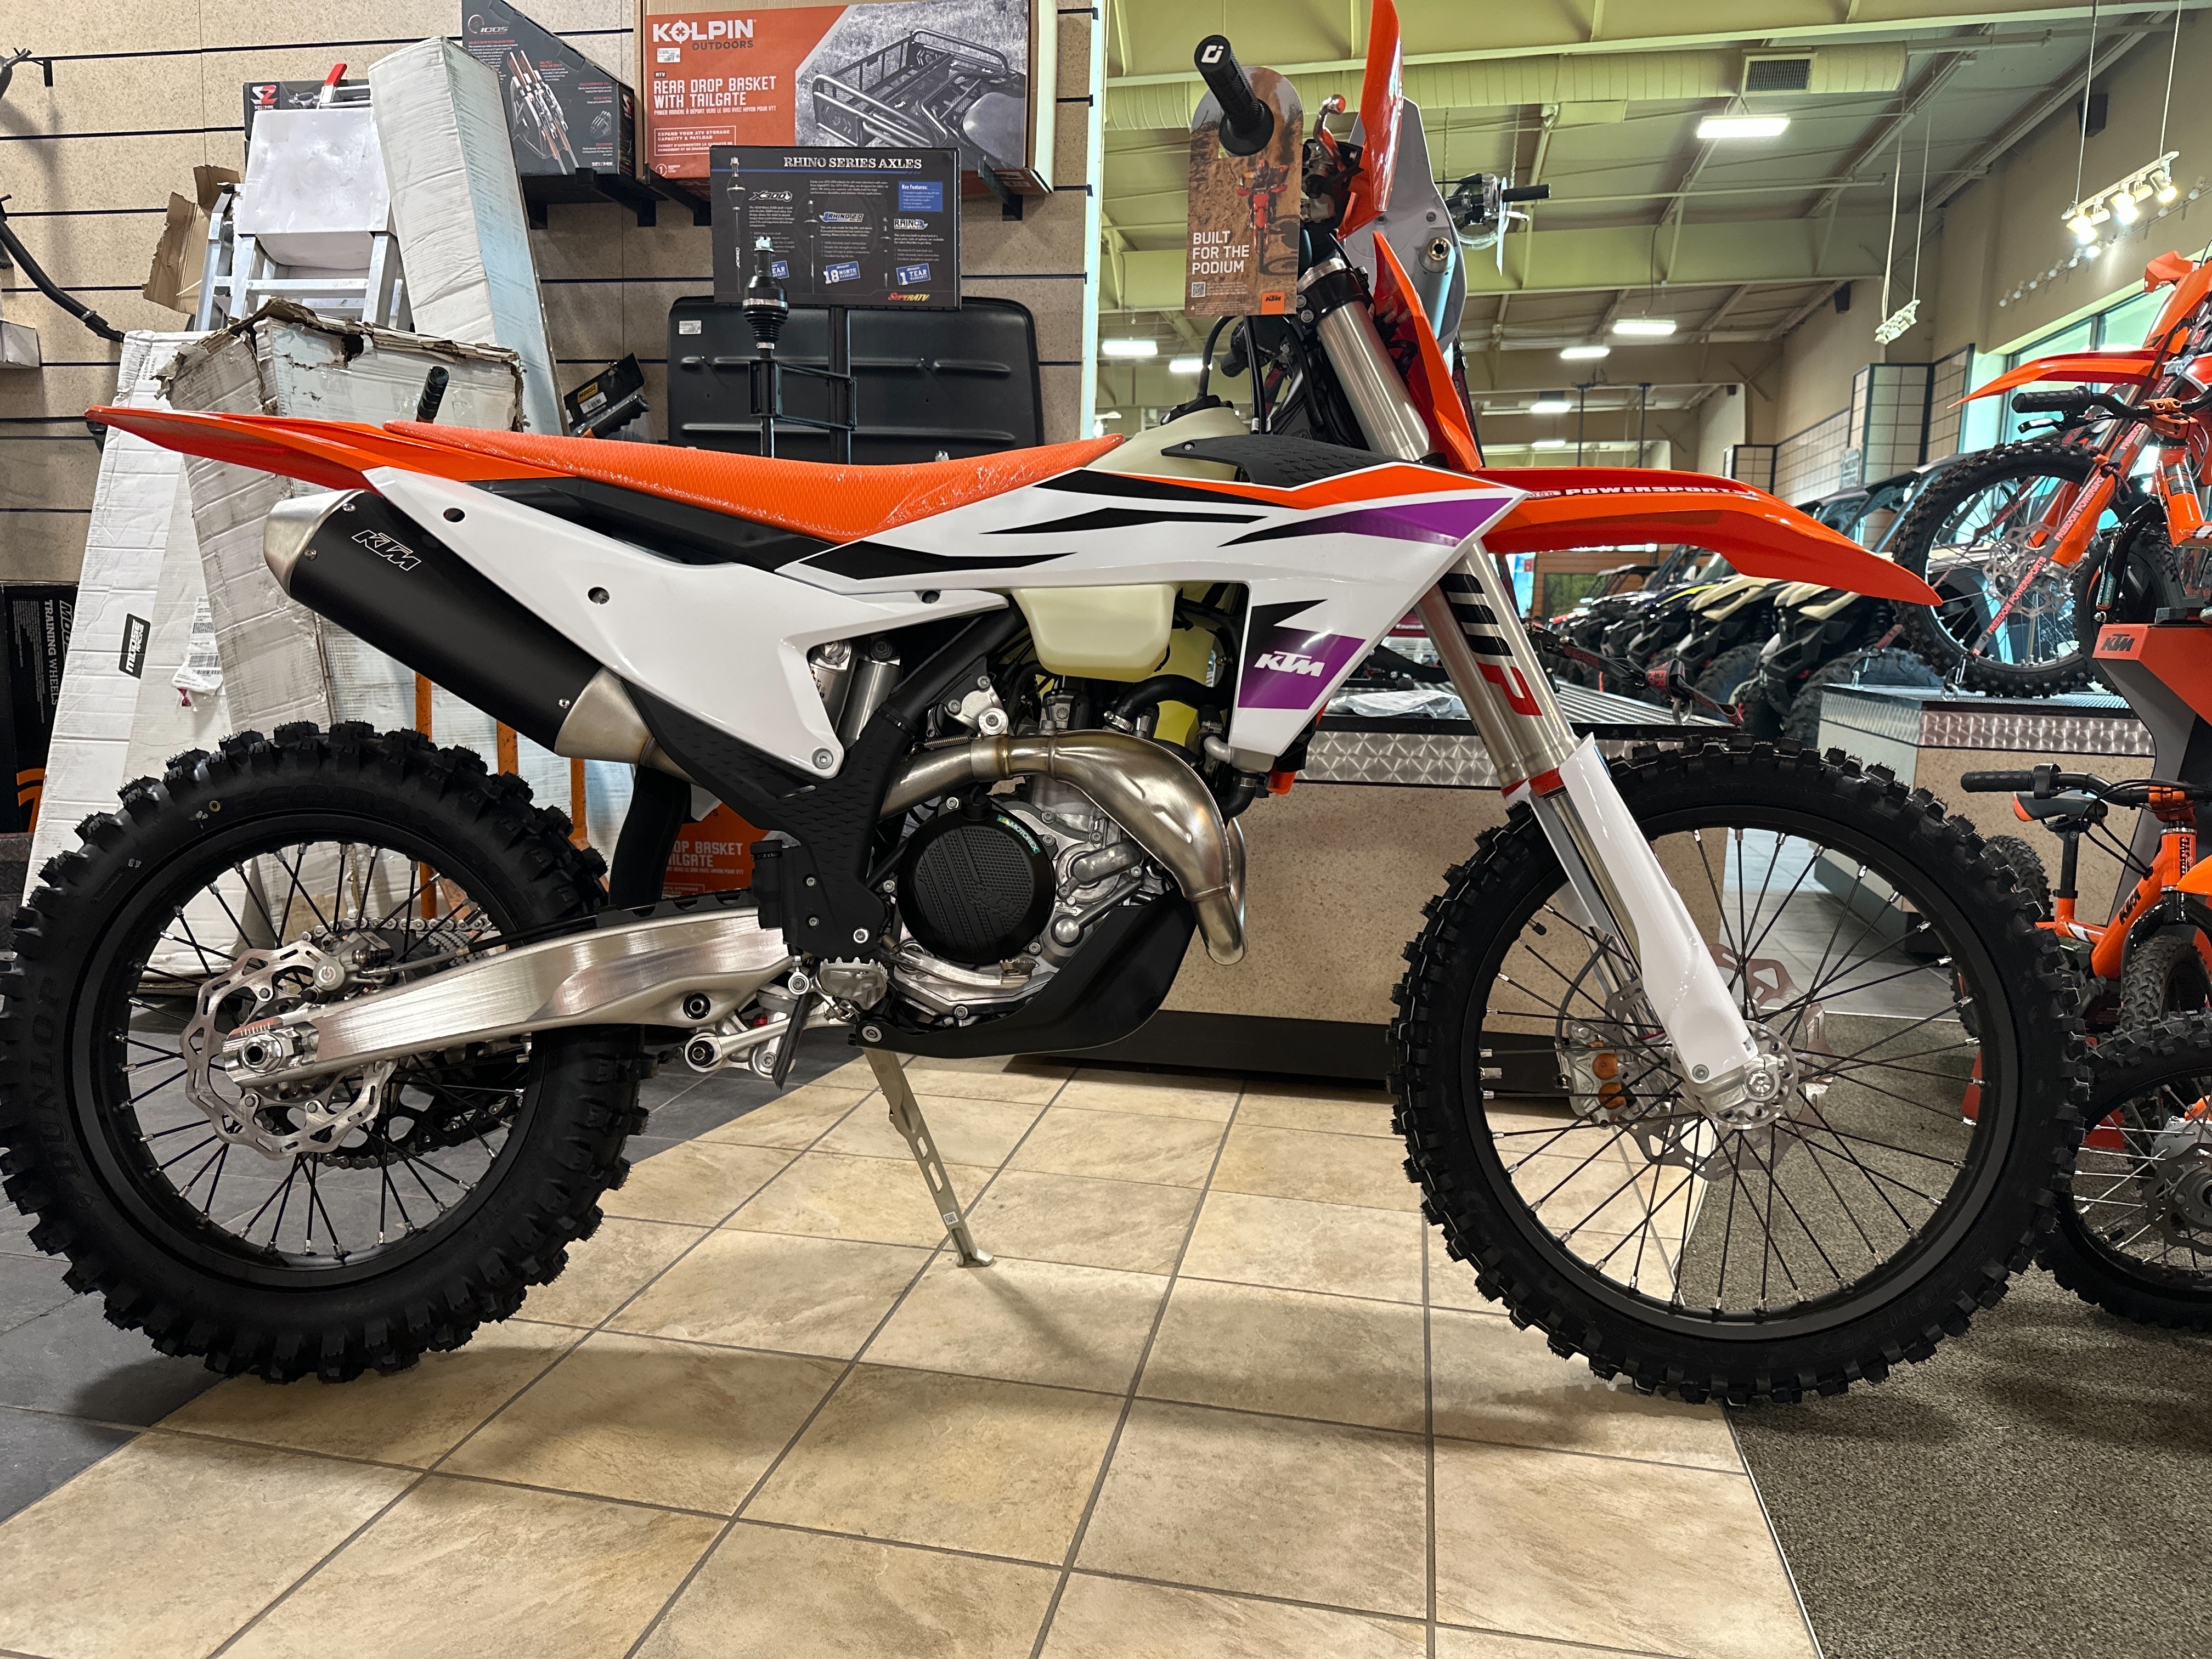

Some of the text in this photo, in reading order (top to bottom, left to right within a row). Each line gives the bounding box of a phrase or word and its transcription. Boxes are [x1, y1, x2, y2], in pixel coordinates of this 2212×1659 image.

[653, 19, 754, 44] KOLPIN
[692, 41, 754, 50] OUTDOORS
[654, 76, 776, 94] REAR DROP BASKET
[654, 92, 747, 109] WITH TAILGATE
[783, 157, 922, 170] RHINO SERIES AXLES
[749, 190, 787, 201] X300
[1193, 230, 1231, 245] BUILT
[1193, 245, 1250, 260] FOR THE
[1192, 260, 1244, 274] PODIUM
[823, 269, 839, 284] 18
[900, 272, 909, 285] 1
[351, 529, 421, 571] KTM
[2101, 634, 2135, 652] KTM
[44, 600, 59, 706] TRAINING WHEELS
[1255, 651, 1325, 677] KTM
[1009, 822, 1038, 851] MOTOREX
[695, 841, 743, 856] BASKET
